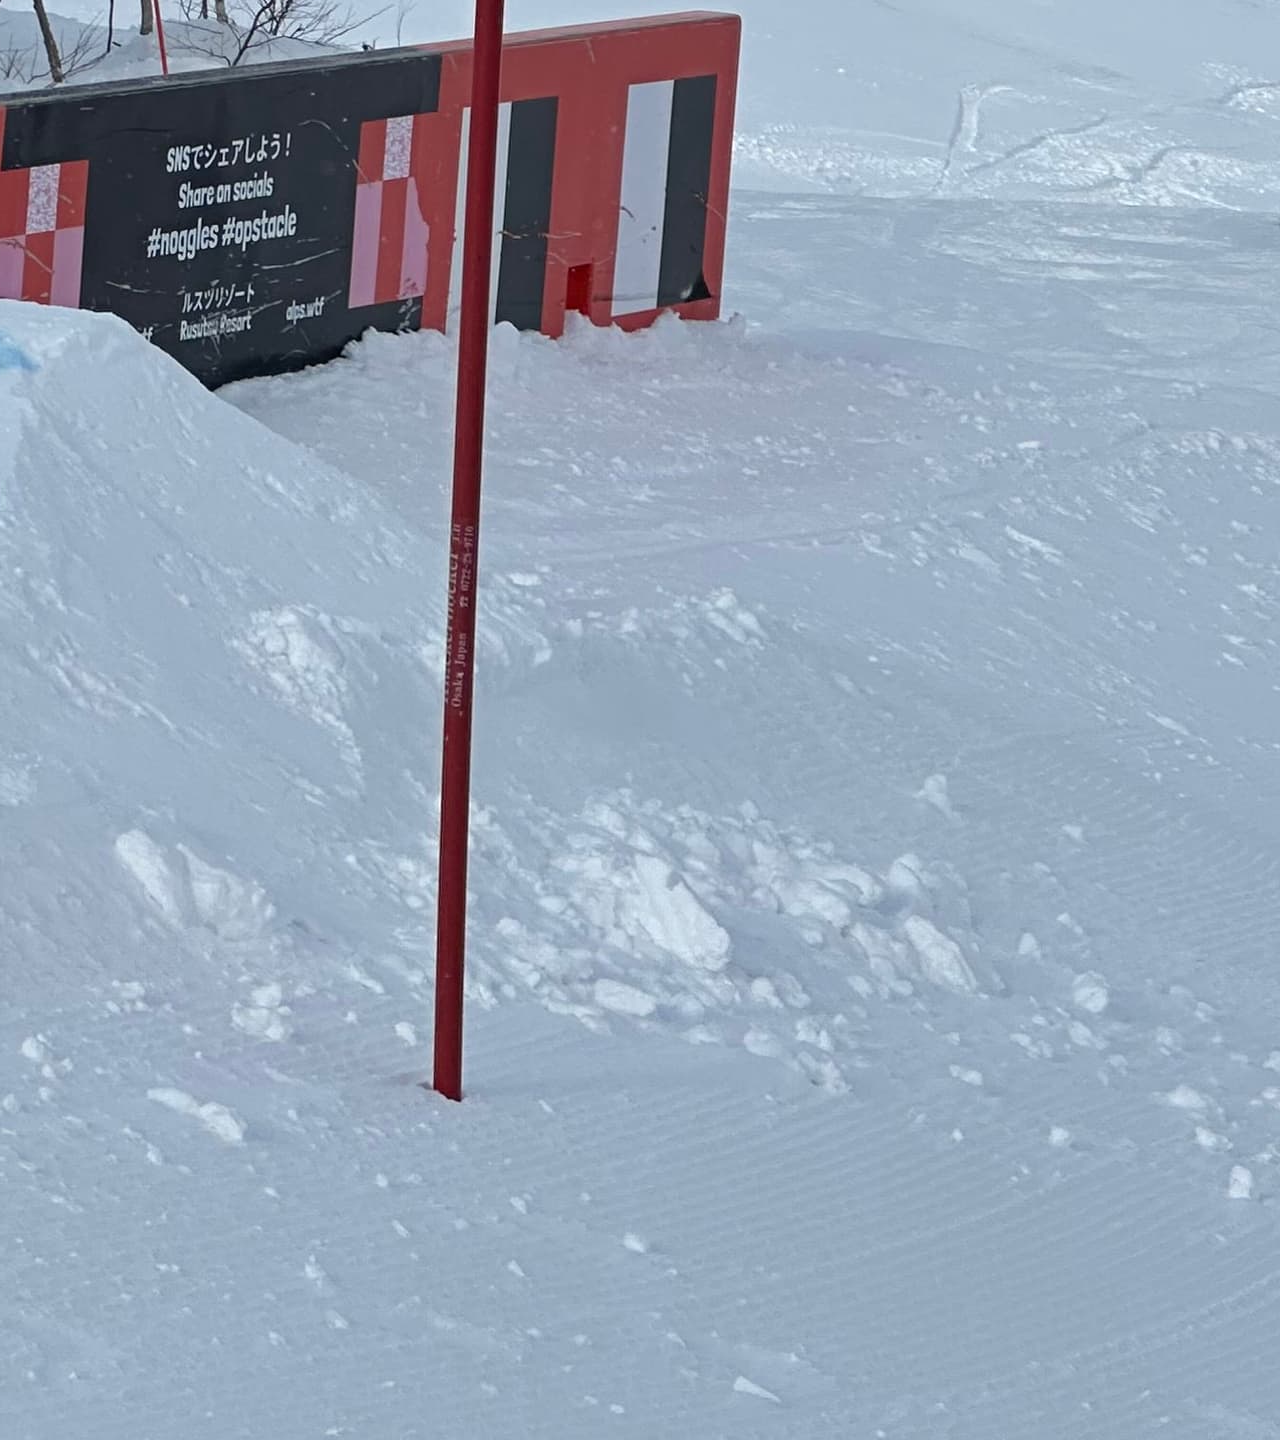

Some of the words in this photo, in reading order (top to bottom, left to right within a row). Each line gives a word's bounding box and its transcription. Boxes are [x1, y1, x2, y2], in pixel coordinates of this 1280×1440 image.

[177, 181, 215, 209] Share
[216, 186, 232, 204] on
[232, 170, 274, 202] socials
[146, 216, 220, 261] #noggles
[221, 203, 298, 252] #opstacle
[454, 632, 468, 668] Japan
